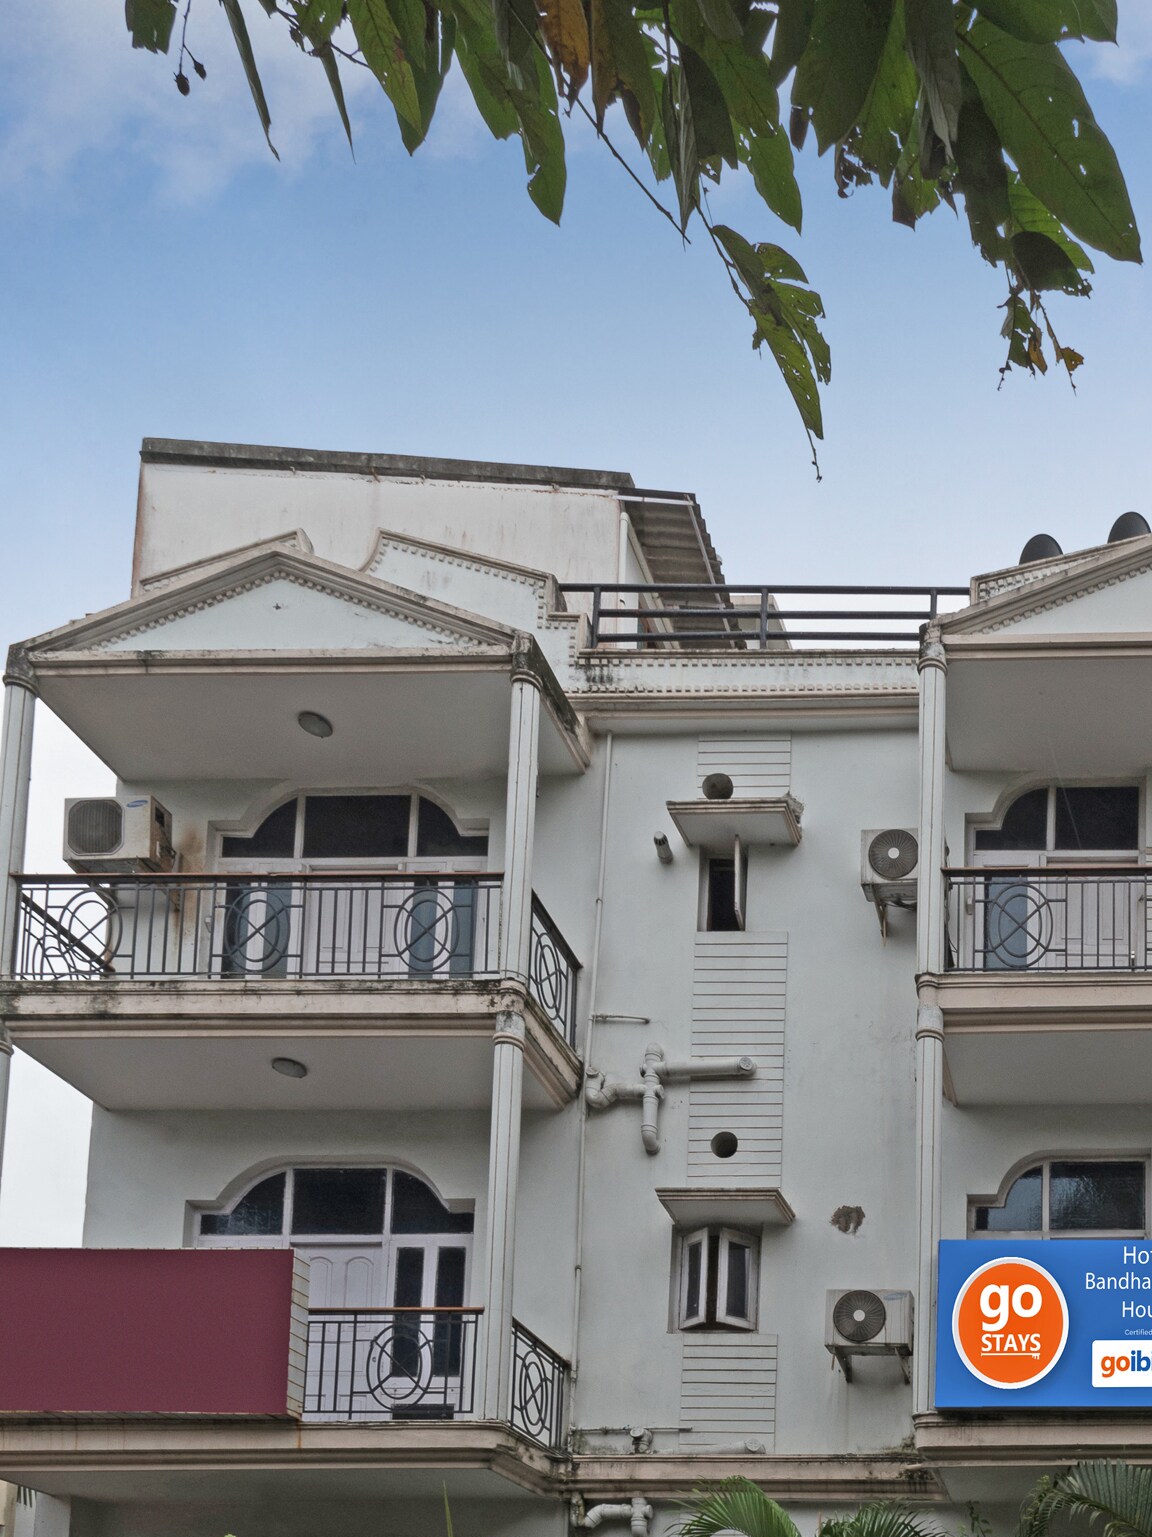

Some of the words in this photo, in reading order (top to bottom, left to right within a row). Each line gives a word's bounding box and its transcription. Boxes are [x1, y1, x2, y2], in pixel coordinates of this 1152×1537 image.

[979, 1283, 1043, 1332] go
[1124, 1328, 1152, 1336] Certified
[981, 1333, 1042, 1352] STAYS
